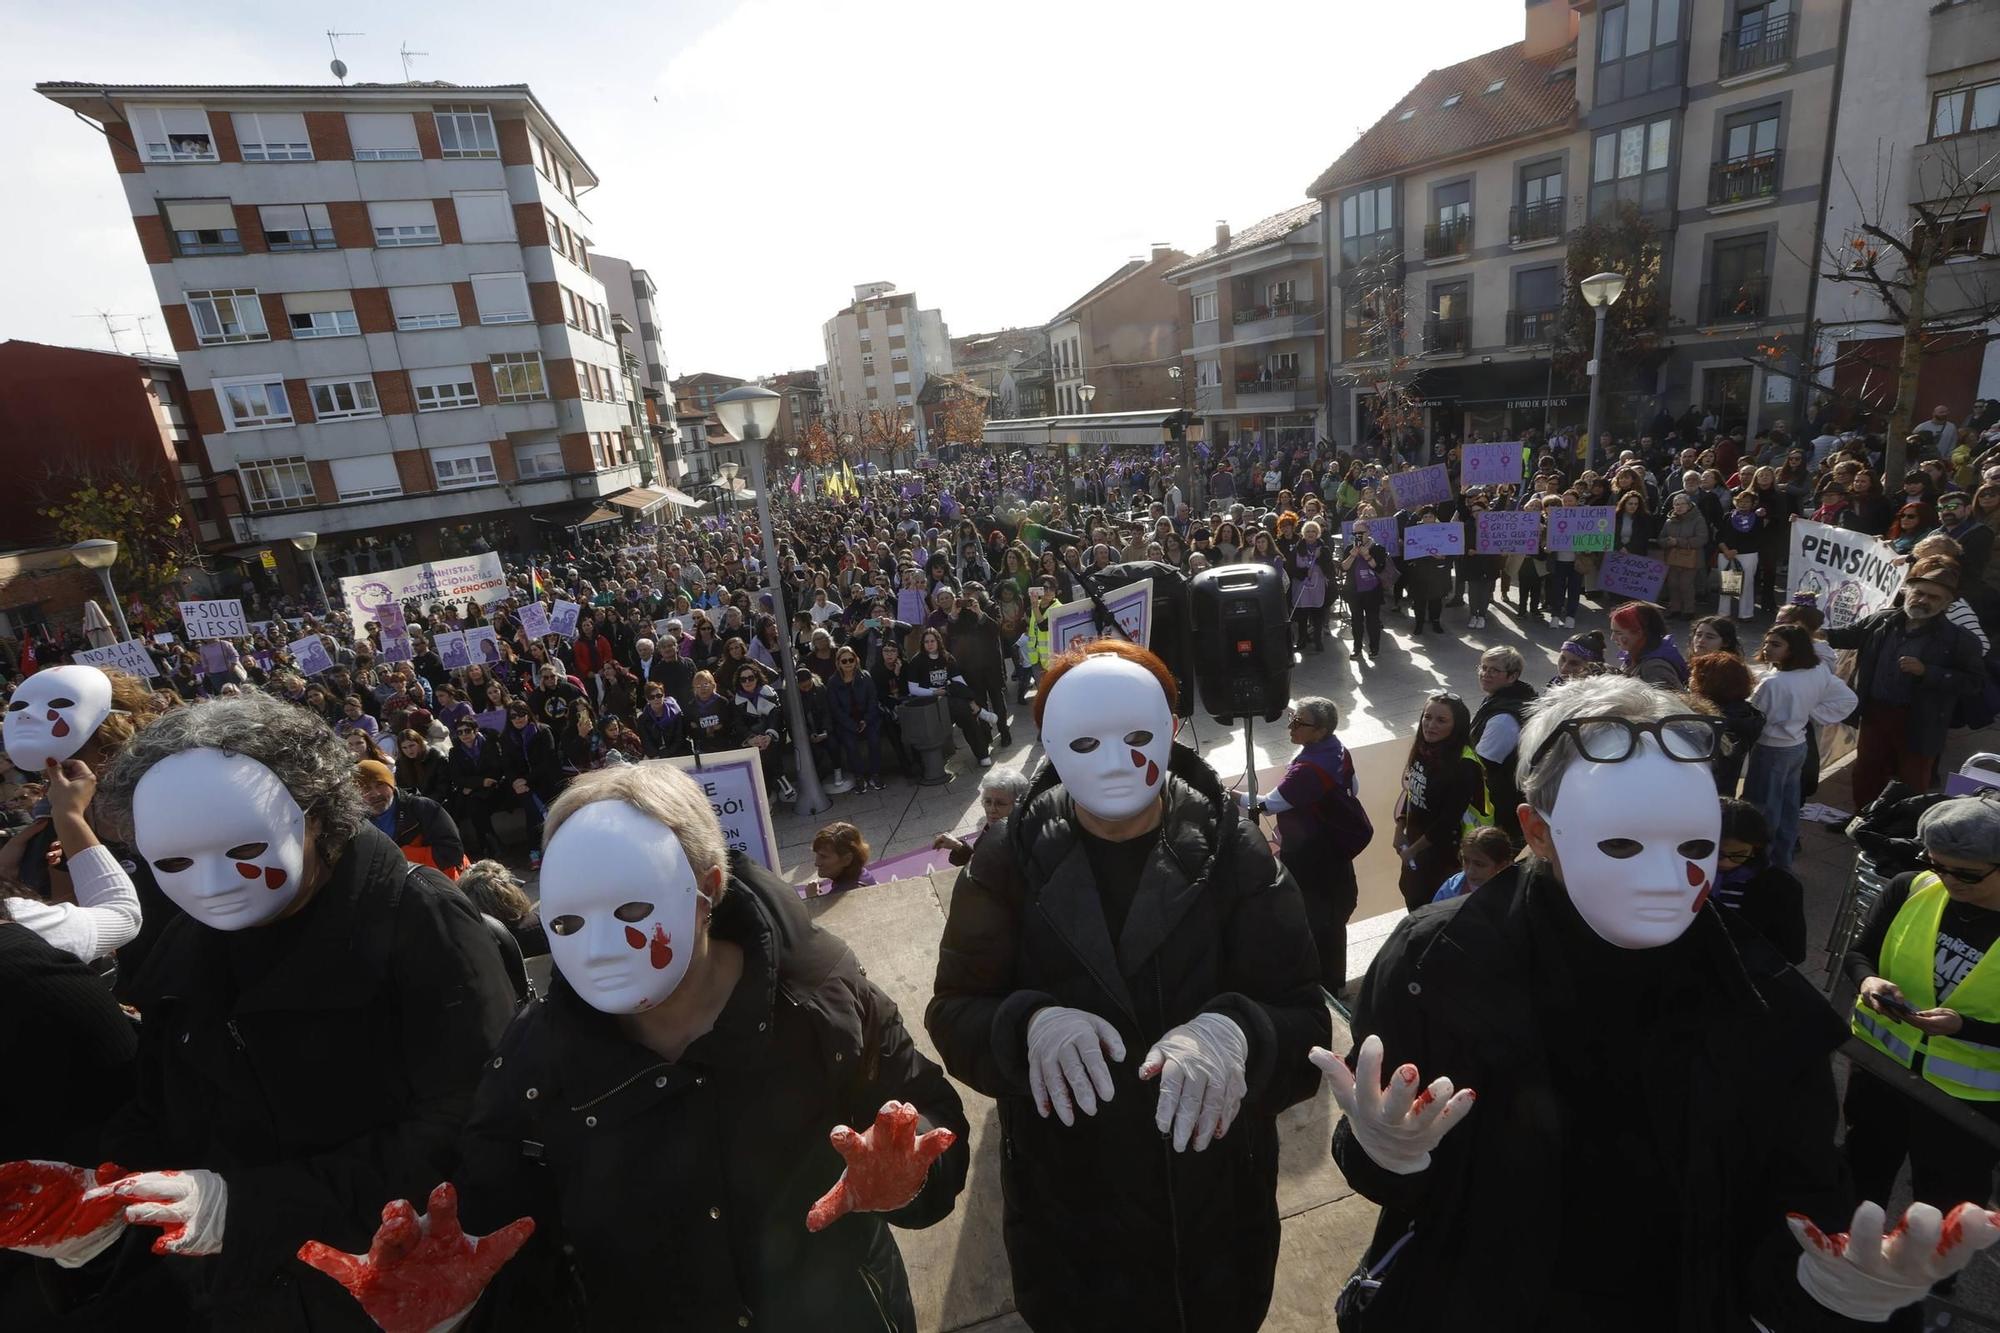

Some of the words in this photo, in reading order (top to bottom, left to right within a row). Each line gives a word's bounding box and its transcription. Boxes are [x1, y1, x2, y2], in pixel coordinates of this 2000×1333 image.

[1484, 511, 1519, 522] SOMOS
[1522, 513, 1534, 522] EL
[1555, 508, 1576, 519] SIN
[1580, 507, 1608, 518] LUCHA
[1490, 522, 1518, 531] GRITO
[1576, 520, 1595, 531] NO
[417, 564, 476, 580] FEMINISTAS
[437, 589, 450, 598] EL
[452, 578, 503, 595] GENOCIDIO
[447, 595, 476, 607] GAZA
[83, 650, 104, 664] NO
[107, 648, 116, 659] A
[118, 643, 137, 656] LA
